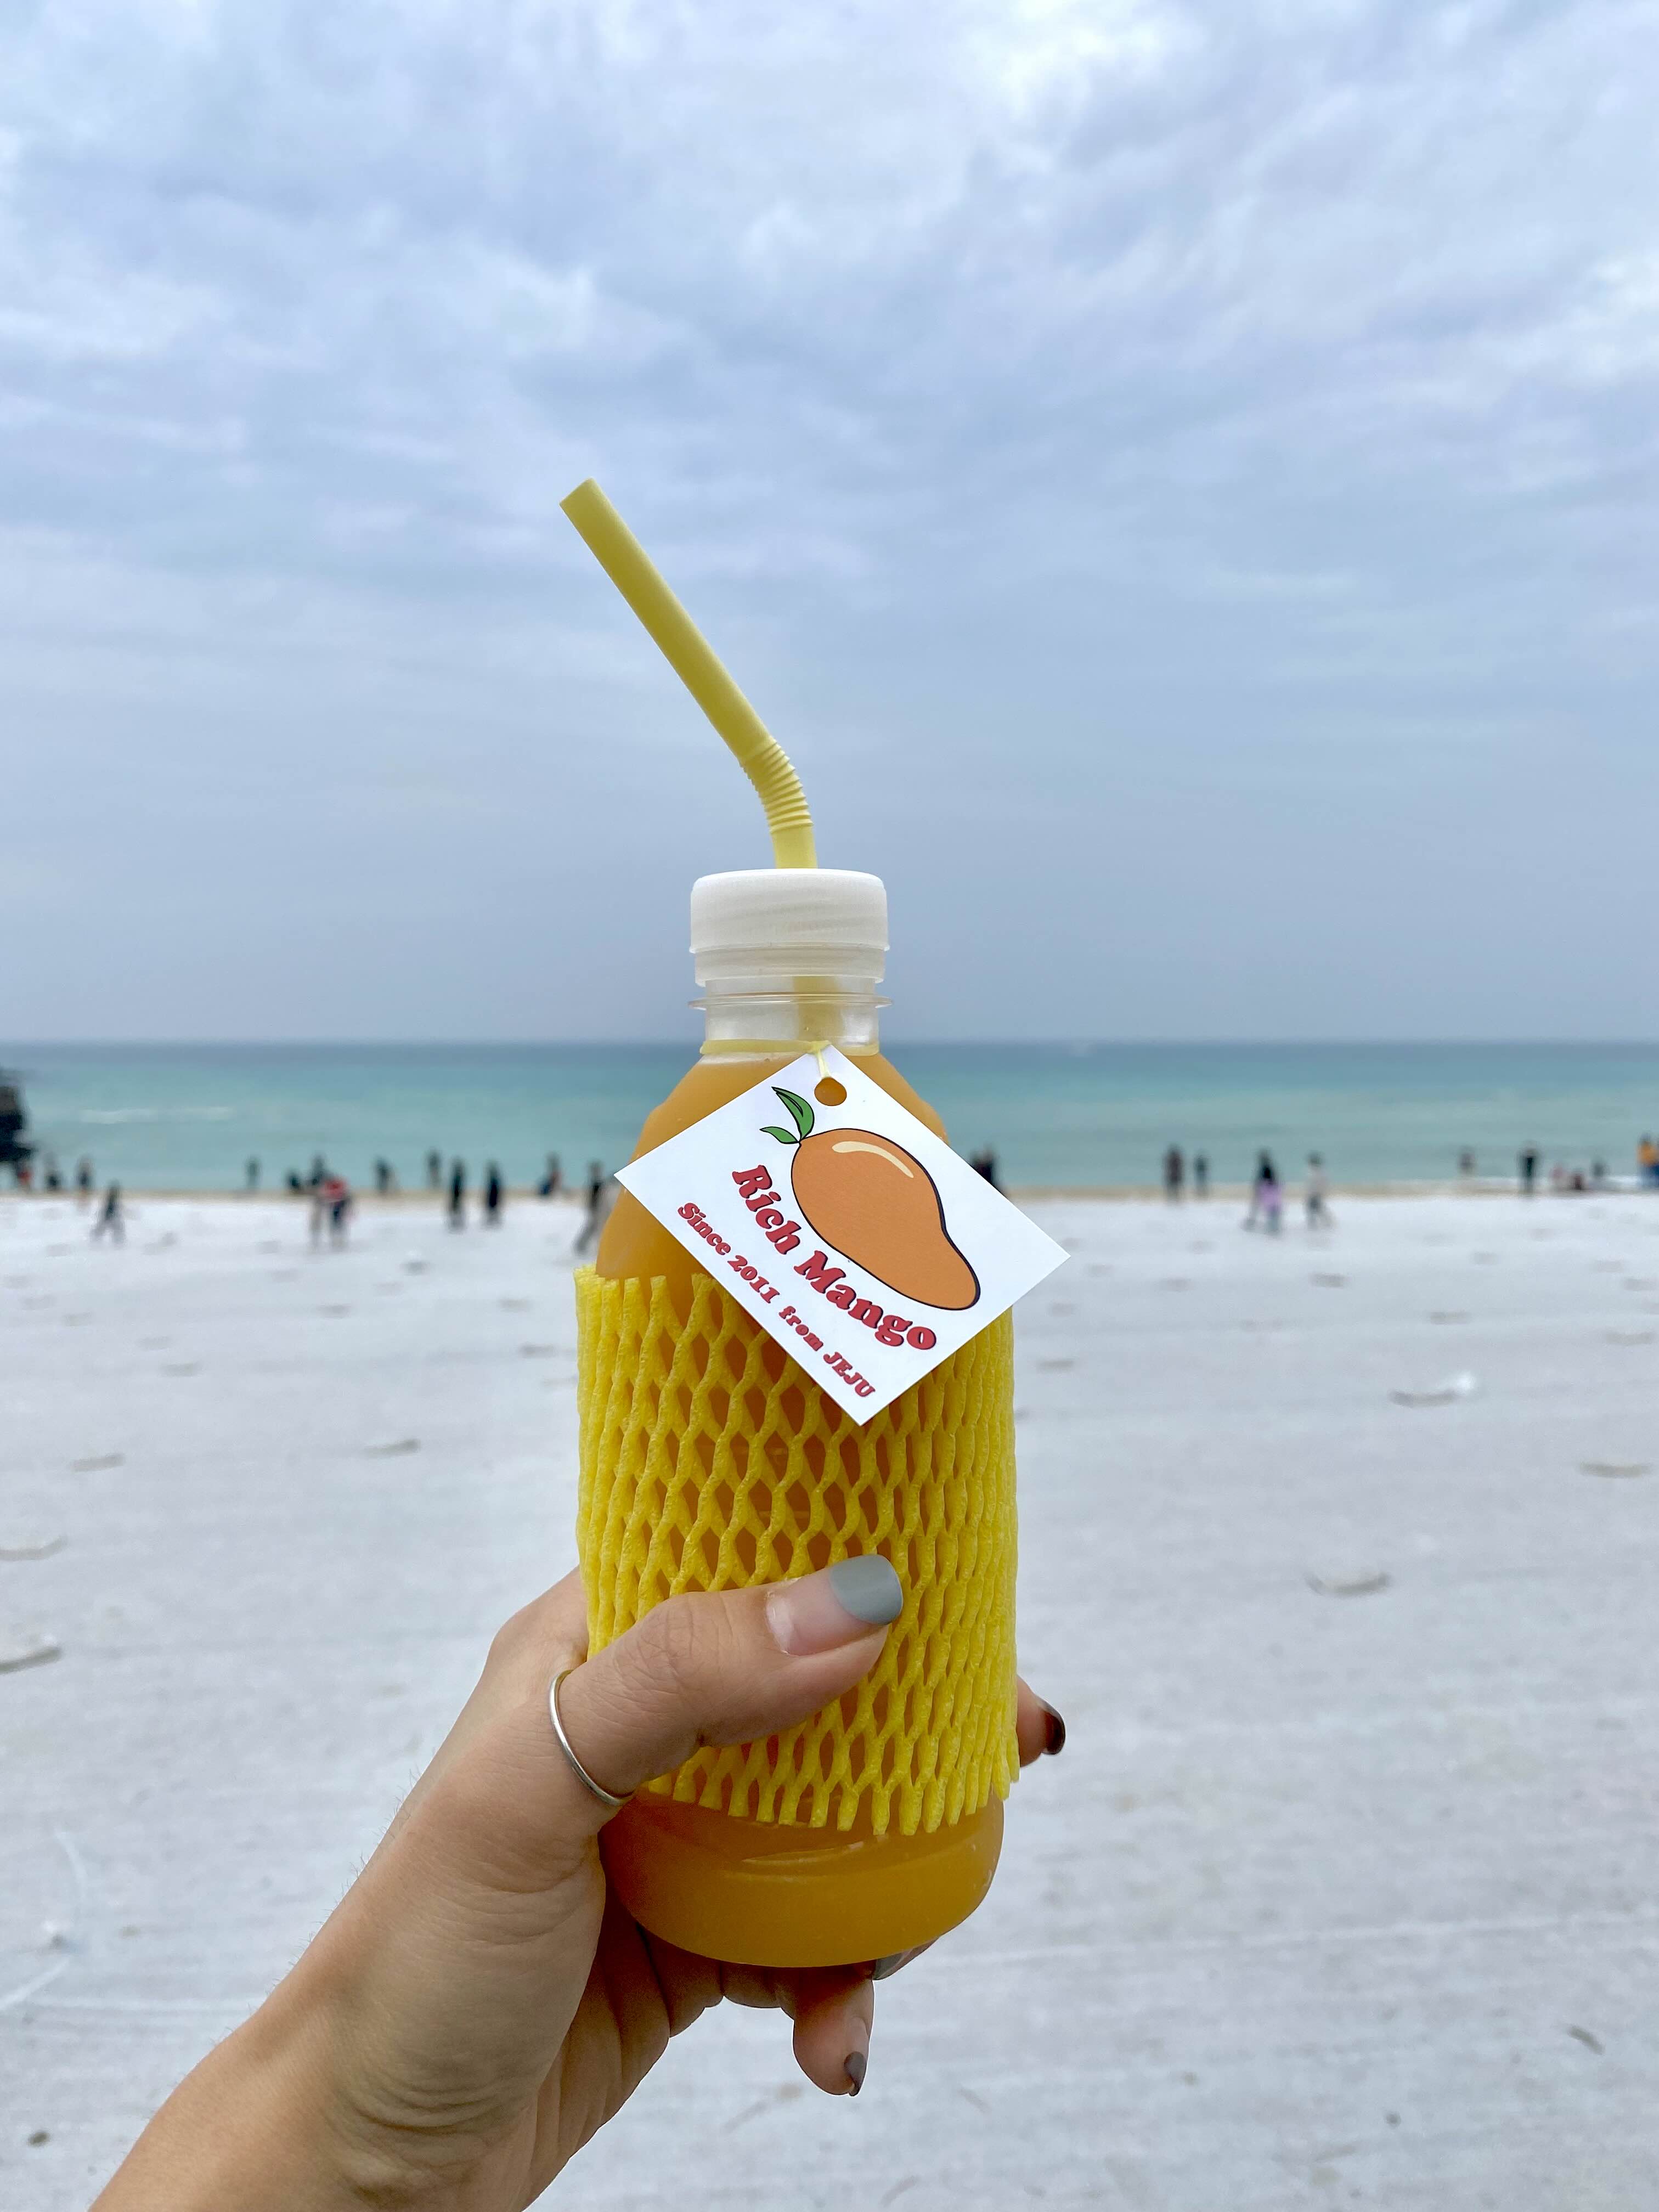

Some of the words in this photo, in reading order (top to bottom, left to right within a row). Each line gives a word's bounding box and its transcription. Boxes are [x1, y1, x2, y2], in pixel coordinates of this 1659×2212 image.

[678, 1203, 731, 1255] Since
[727, 1255, 780, 1304] 2011
[778, 1306, 824, 1351] from
[823, 1351, 876, 1397] JEJU
[731, 1164, 802, 1255] Rich
[793, 1250, 937, 1350] Mango
